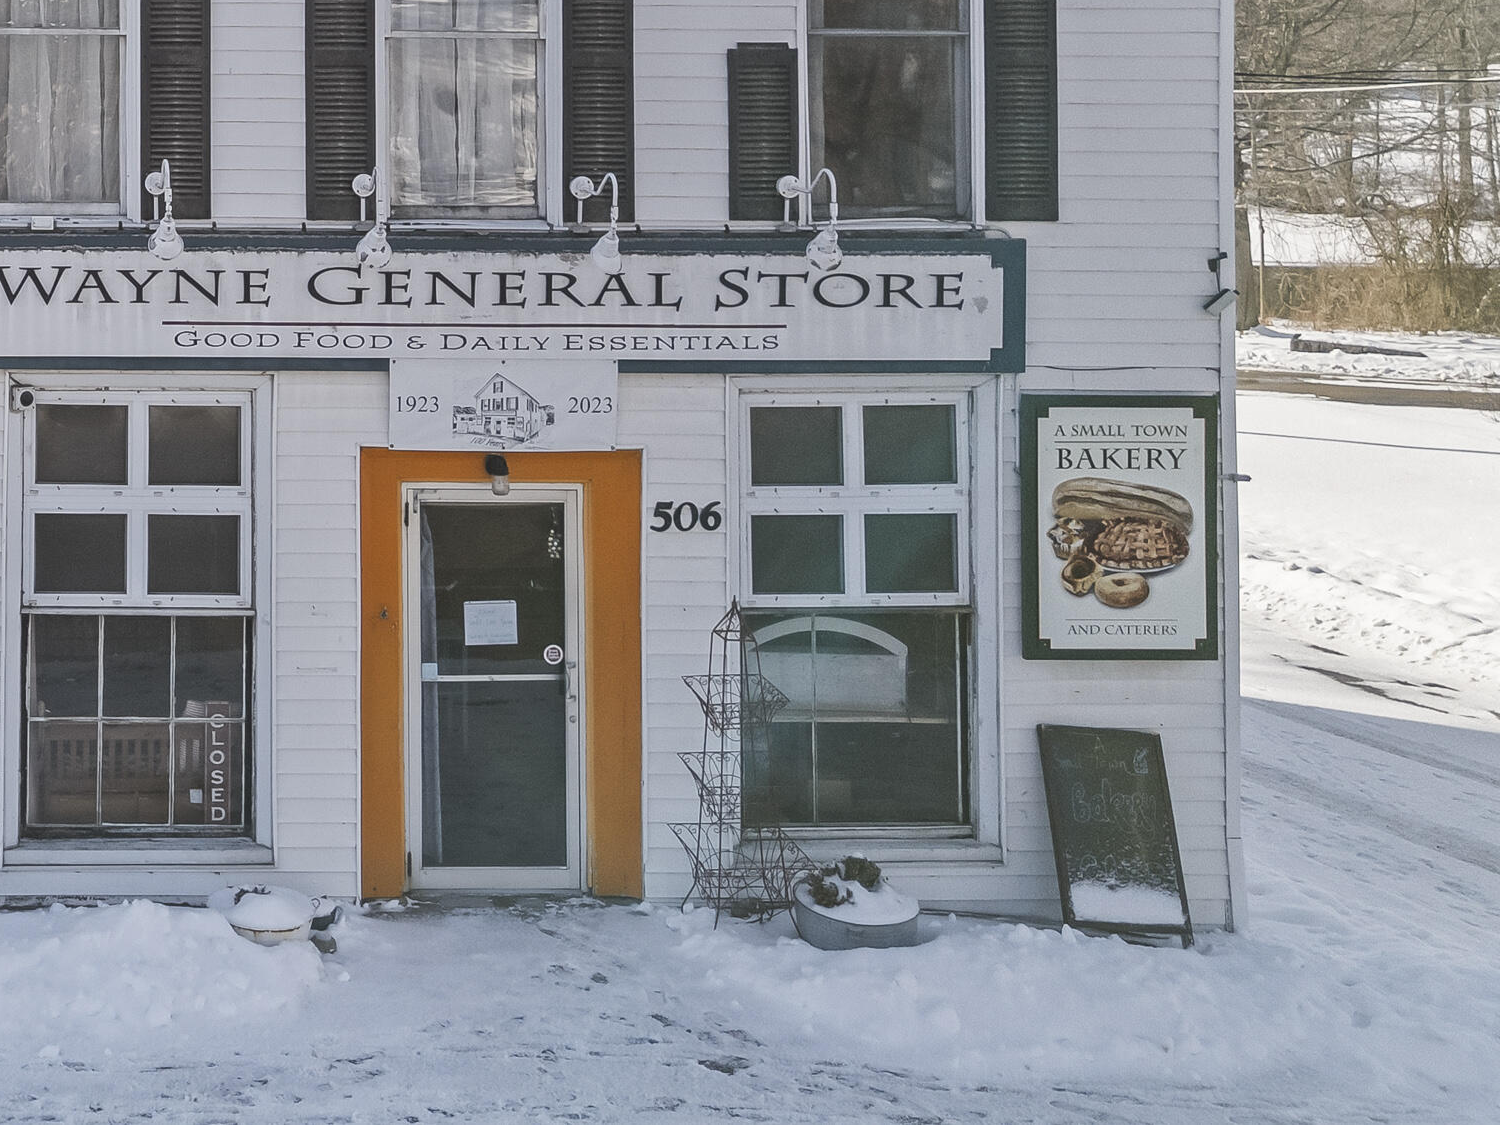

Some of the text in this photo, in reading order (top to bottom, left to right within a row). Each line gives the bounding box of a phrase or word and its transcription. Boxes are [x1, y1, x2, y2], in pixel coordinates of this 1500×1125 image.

[307, 265, 683, 309] GENERAL
[714, 266, 965, 311] STORE
[174, 330, 780, 352] GOOD FOOD & DAILY ESSENTIALS
[396, 395, 440, 413] 1923
[568, 396, 613, 414] 2023
[1054, 425, 1188, 437] A SMALL TOWN
[1055, 448, 1187, 471] BAKERY
[649, 501, 722, 533] 506
[1068, 625, 1178, 636] AND CATERERS
[210, 713, 226, 821] CLOSED
